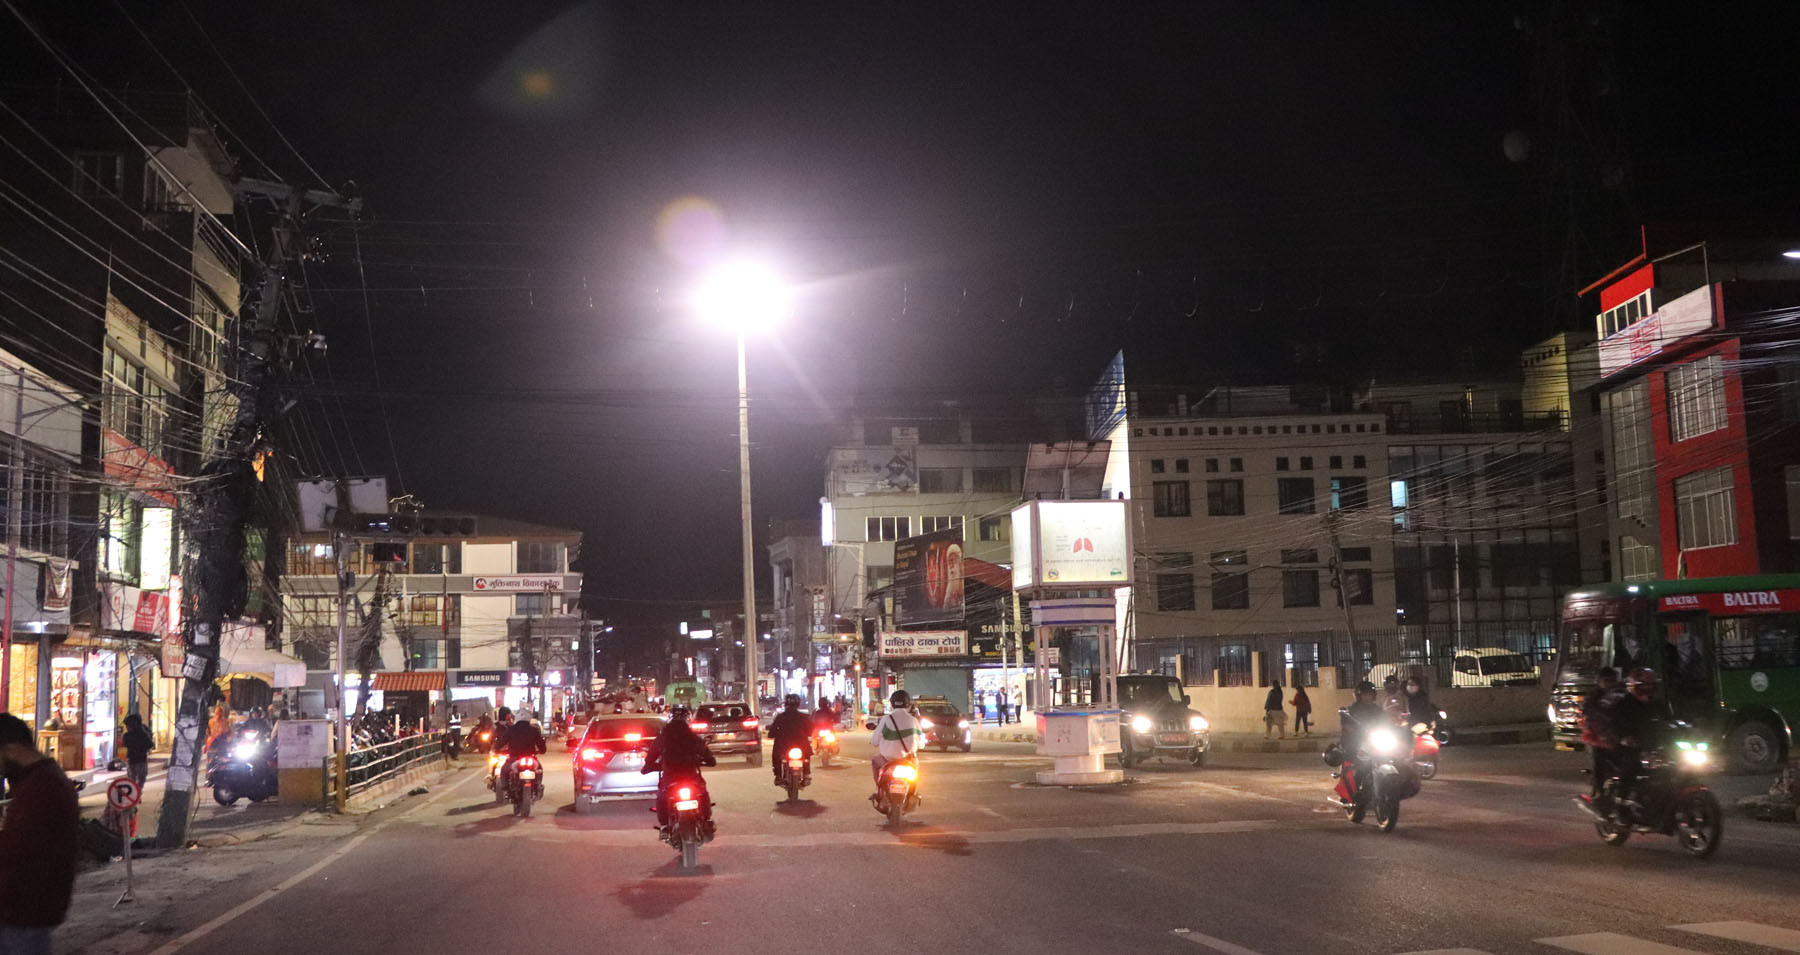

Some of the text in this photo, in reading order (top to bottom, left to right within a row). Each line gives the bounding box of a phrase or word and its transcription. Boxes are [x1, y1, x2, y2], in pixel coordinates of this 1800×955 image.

[1723, 591, 1780, 607] BALTRA
[917, 637, 940, 647] ढाका
[942, 636, 961, 647] टोपी
[464, 674, 501, 682] SAMSUNG
[116, 784, 133, 803] P
